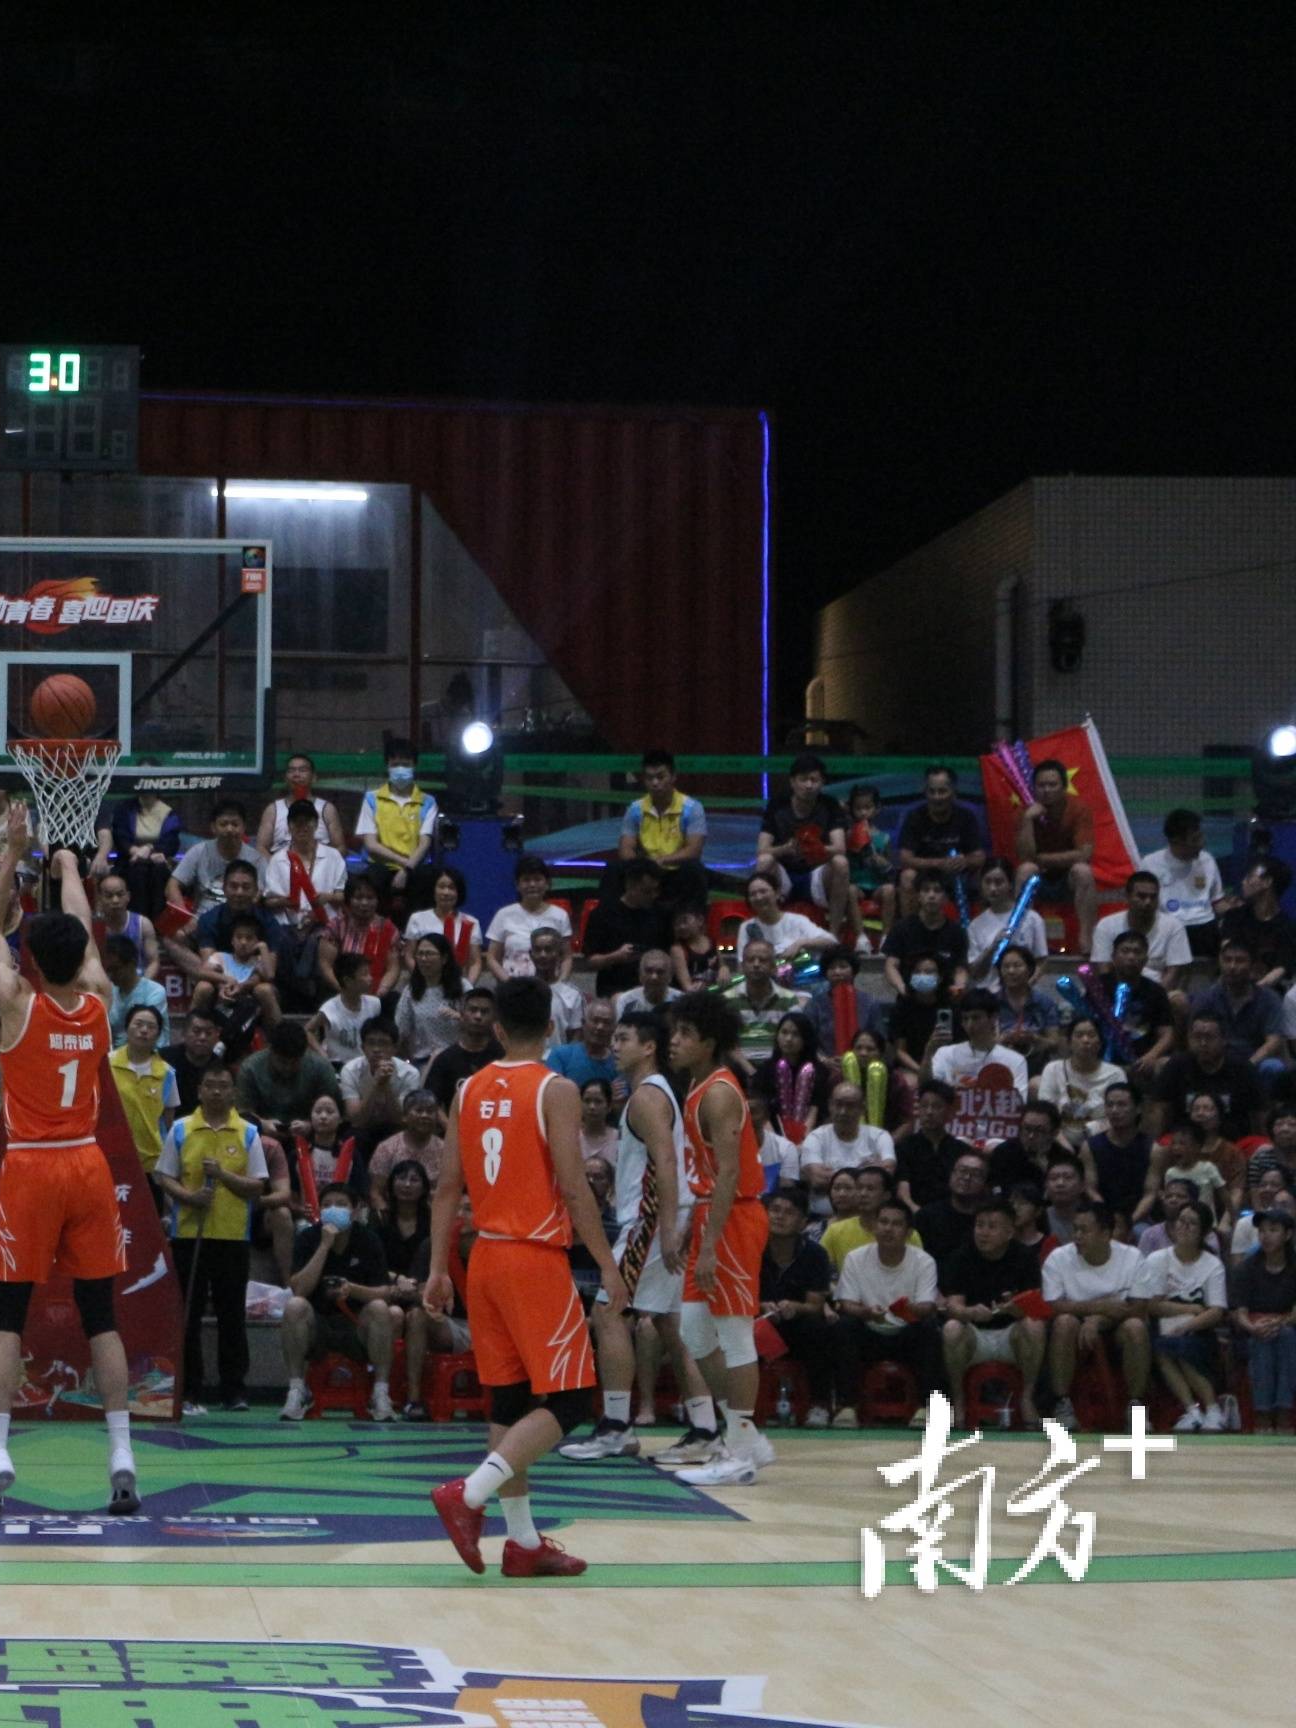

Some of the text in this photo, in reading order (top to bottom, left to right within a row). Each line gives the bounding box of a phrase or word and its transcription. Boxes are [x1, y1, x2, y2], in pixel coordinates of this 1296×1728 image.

[58, 595, 159, 625] 喜迎国庆
[58, 1059, 80, 1107] 1
[482, 1127, 503, 1186] 8
